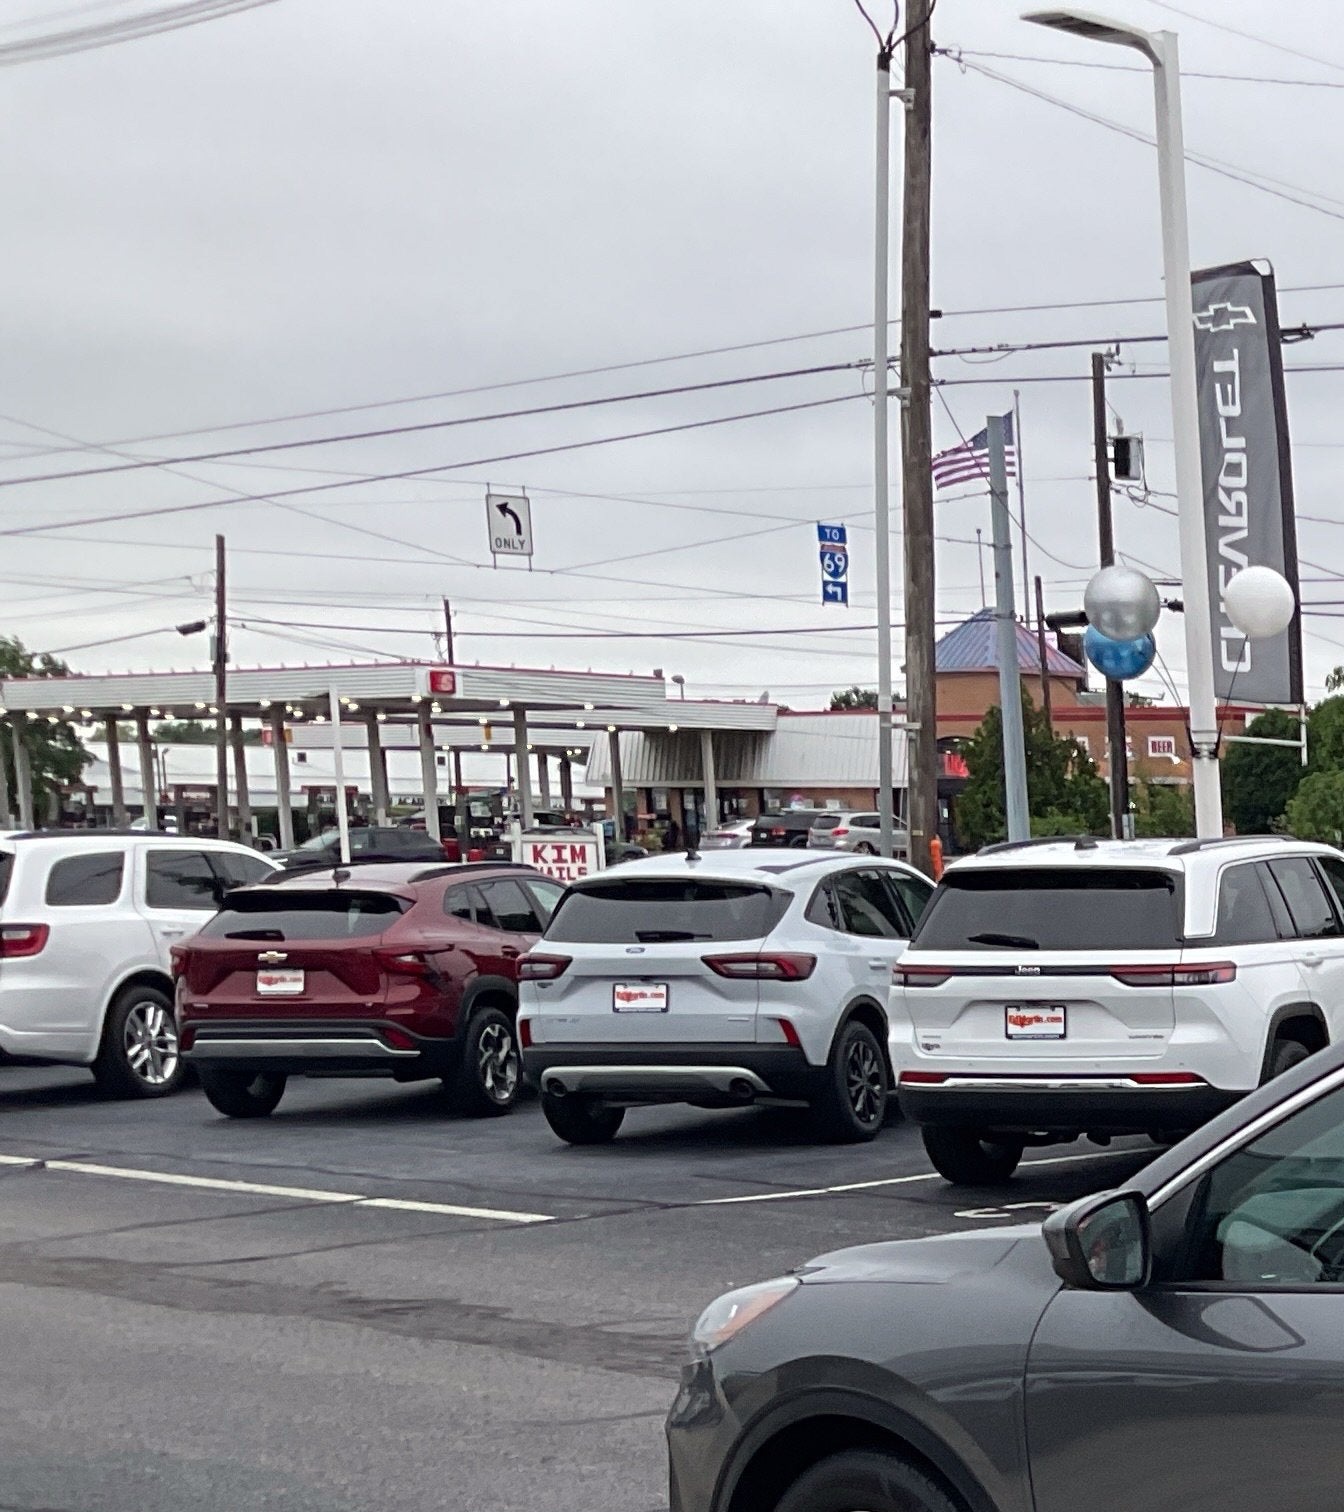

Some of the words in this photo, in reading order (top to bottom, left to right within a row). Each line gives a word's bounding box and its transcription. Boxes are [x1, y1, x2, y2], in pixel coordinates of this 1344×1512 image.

[824, 528, 840, 541] TO
[494, 537, 526, 550] ONLY
[823, 552, 846, 573] 69
[1151, 740, 1173, 753] BEER
[532, 844, 587, 864] KIM
[538, 866, 588, 880] AILS
